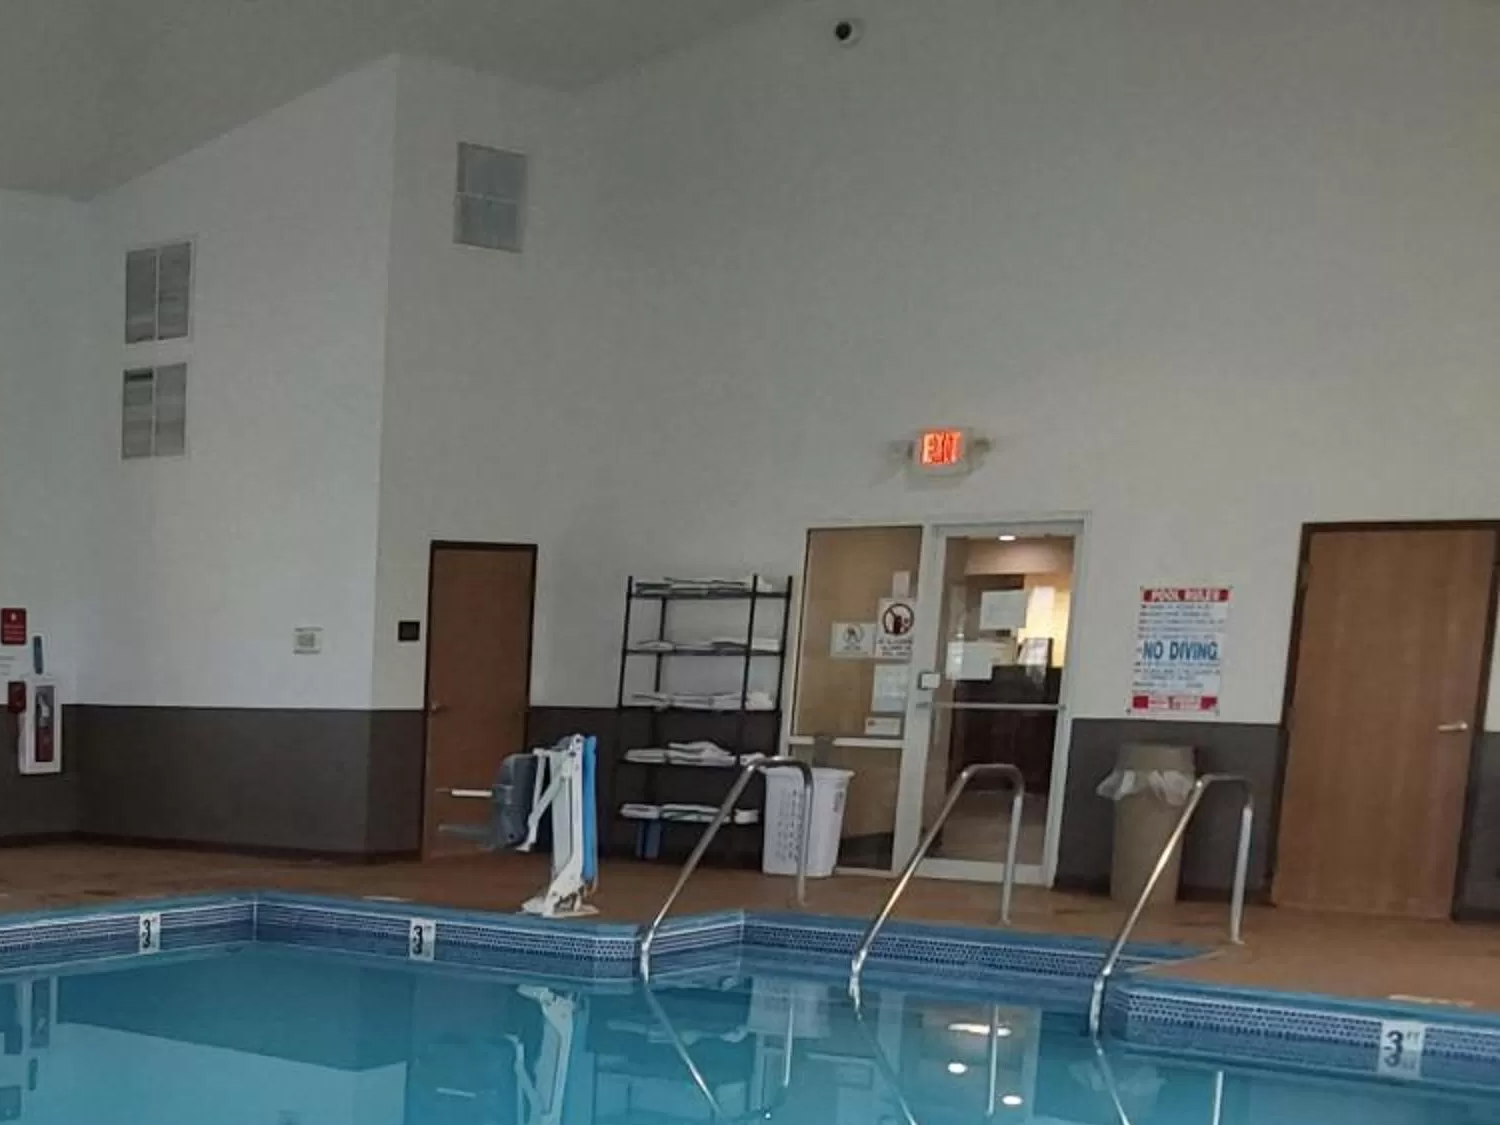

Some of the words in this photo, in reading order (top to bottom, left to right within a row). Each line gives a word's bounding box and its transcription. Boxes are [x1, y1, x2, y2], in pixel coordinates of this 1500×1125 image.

[922, 432, 960, 464] EXIT
[1143, 641, 1164, 659] NO
[1169, 641, 1218, 661] DIVING
